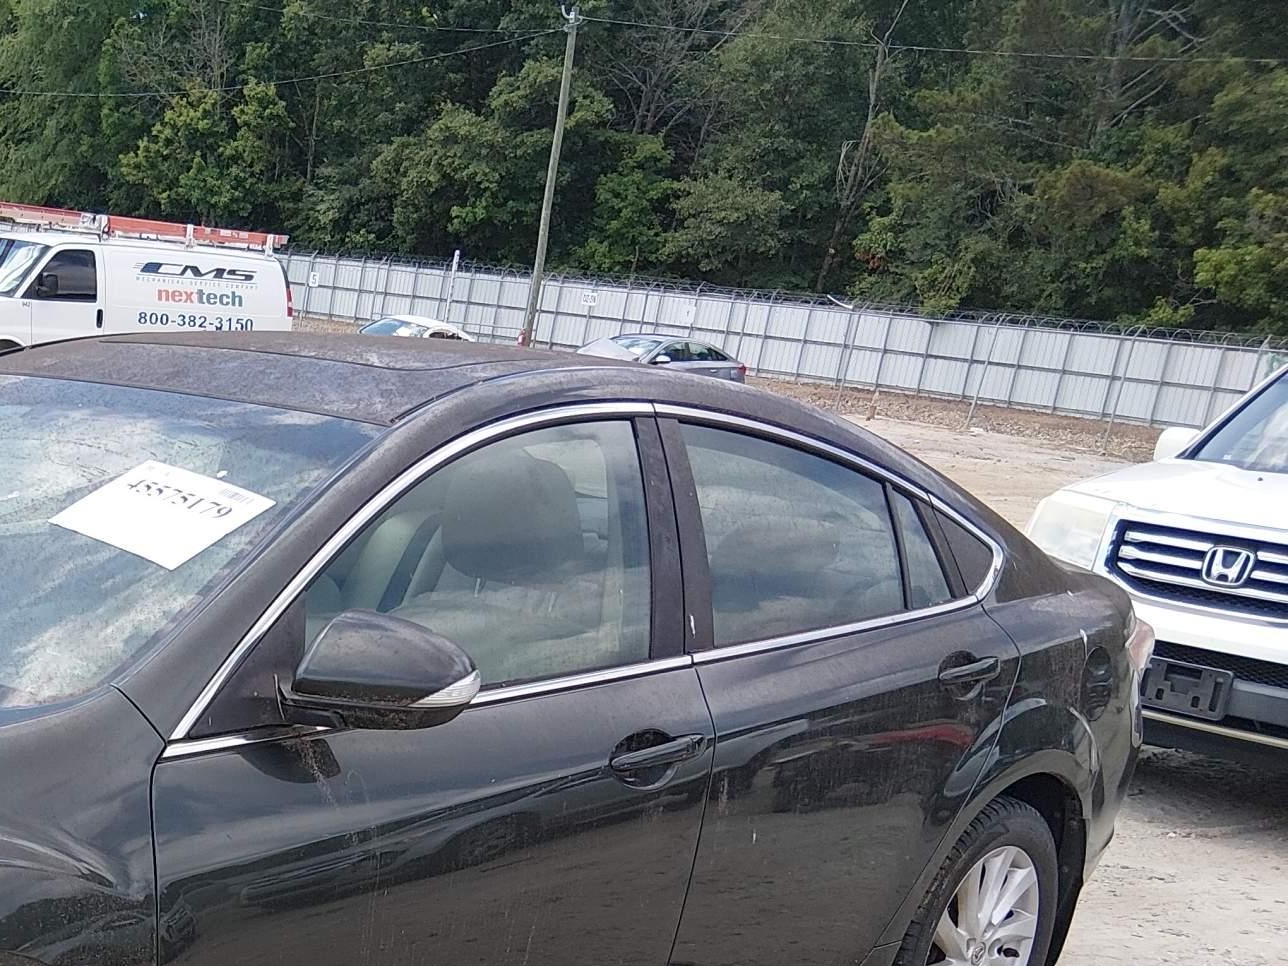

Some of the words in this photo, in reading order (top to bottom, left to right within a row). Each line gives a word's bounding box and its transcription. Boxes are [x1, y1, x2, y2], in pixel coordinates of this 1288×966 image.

[141, 262, 257, 281] CMS
[158, 288, 243, 307] nextech
[138, 311, 254, 331] 800-382-3150
[128, 479, 233, 519] 45575179
